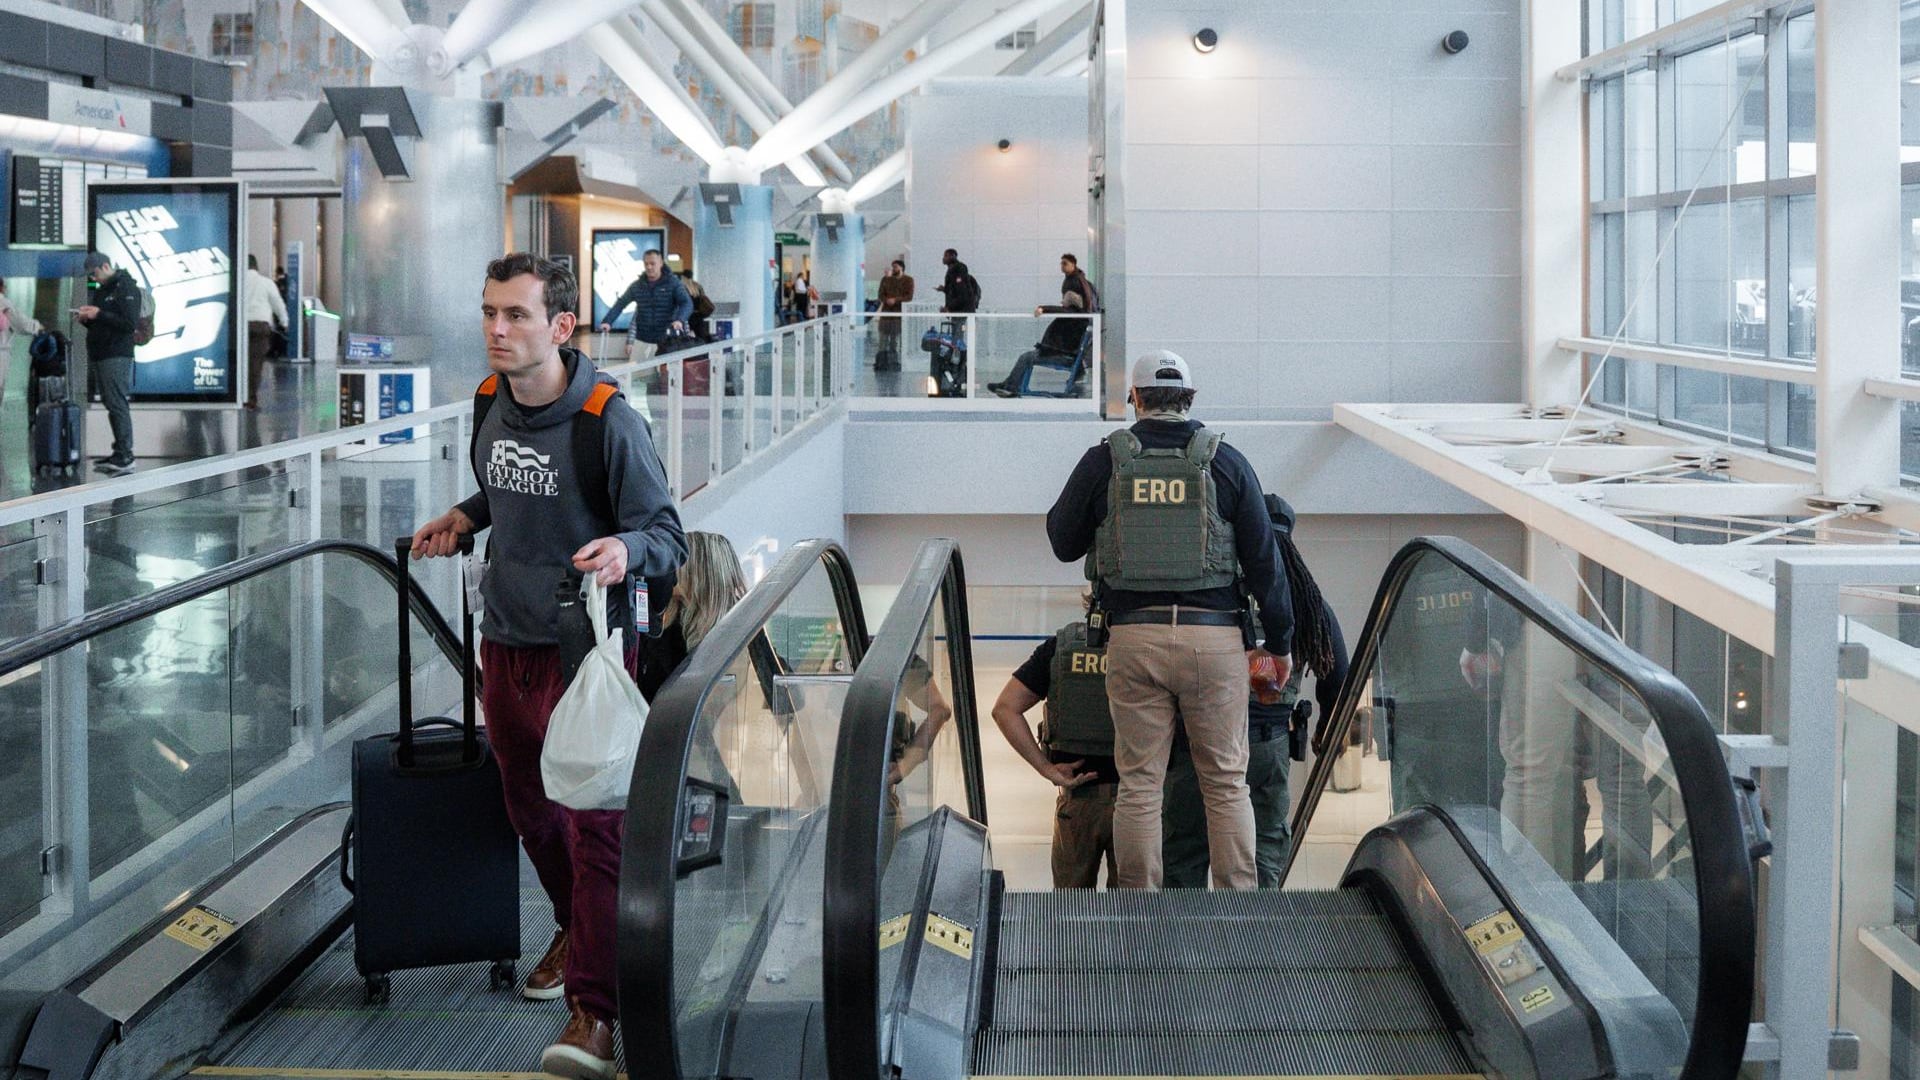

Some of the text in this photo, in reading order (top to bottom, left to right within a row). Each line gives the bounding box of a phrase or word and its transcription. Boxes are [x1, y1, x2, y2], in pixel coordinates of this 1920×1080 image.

[102, 205, 179, 237] TEACH
[193, 357, 214, 368] The
[194, 367, 225, 378] Power
[194, 376, 219, 386] of Us
[486, 461, 559, 484] PATRIOT
[487, 473, 559, 496] LEAGUE
[1133, 478, 1186, 504] ERO
